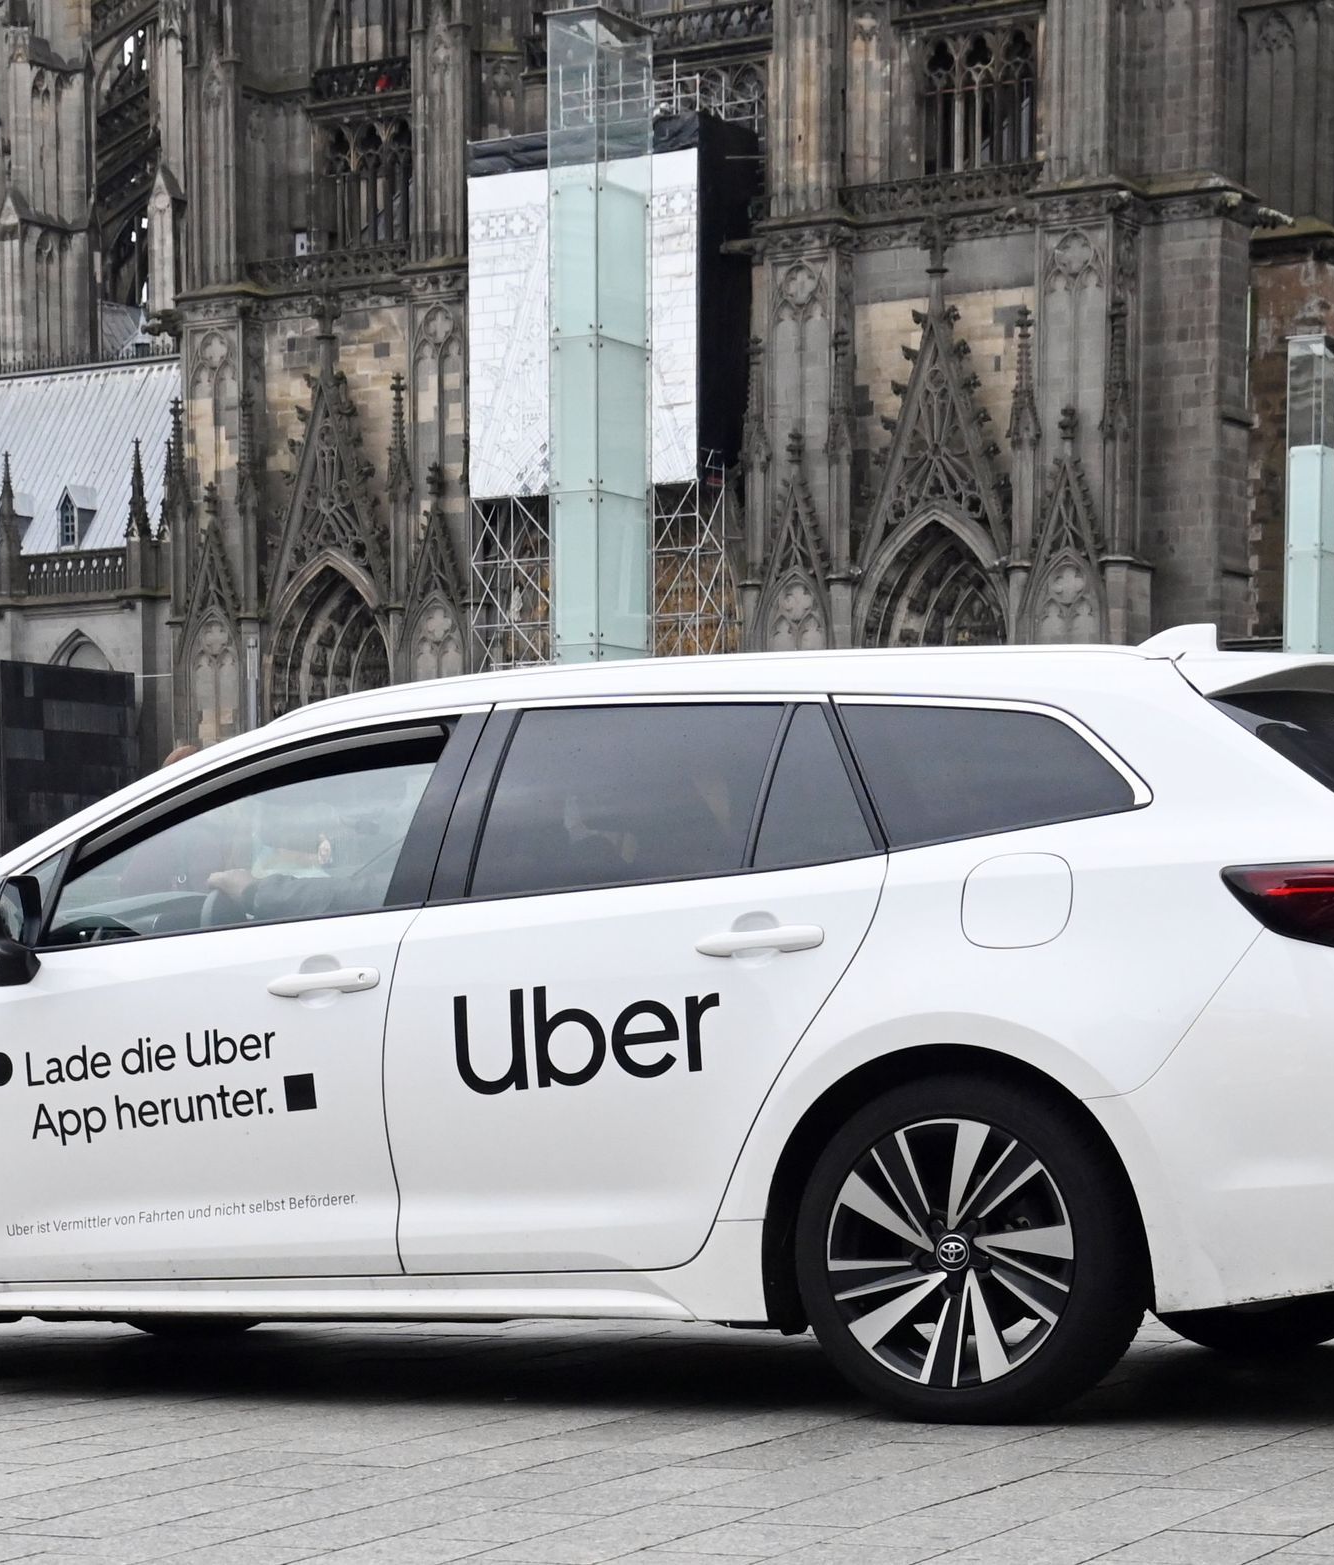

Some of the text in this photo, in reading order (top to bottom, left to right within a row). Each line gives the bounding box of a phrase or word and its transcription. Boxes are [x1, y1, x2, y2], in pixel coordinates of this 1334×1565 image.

[24, 1029, 276, 1087] Lade die Uber
[453, 985, 720, 1095] Uber
[31, 1084, 275, 1146] App herunter.
[6, 1193, 358, 1237] Uber ist Vermittler von Fahrten und nicht selbst Beförderer.
